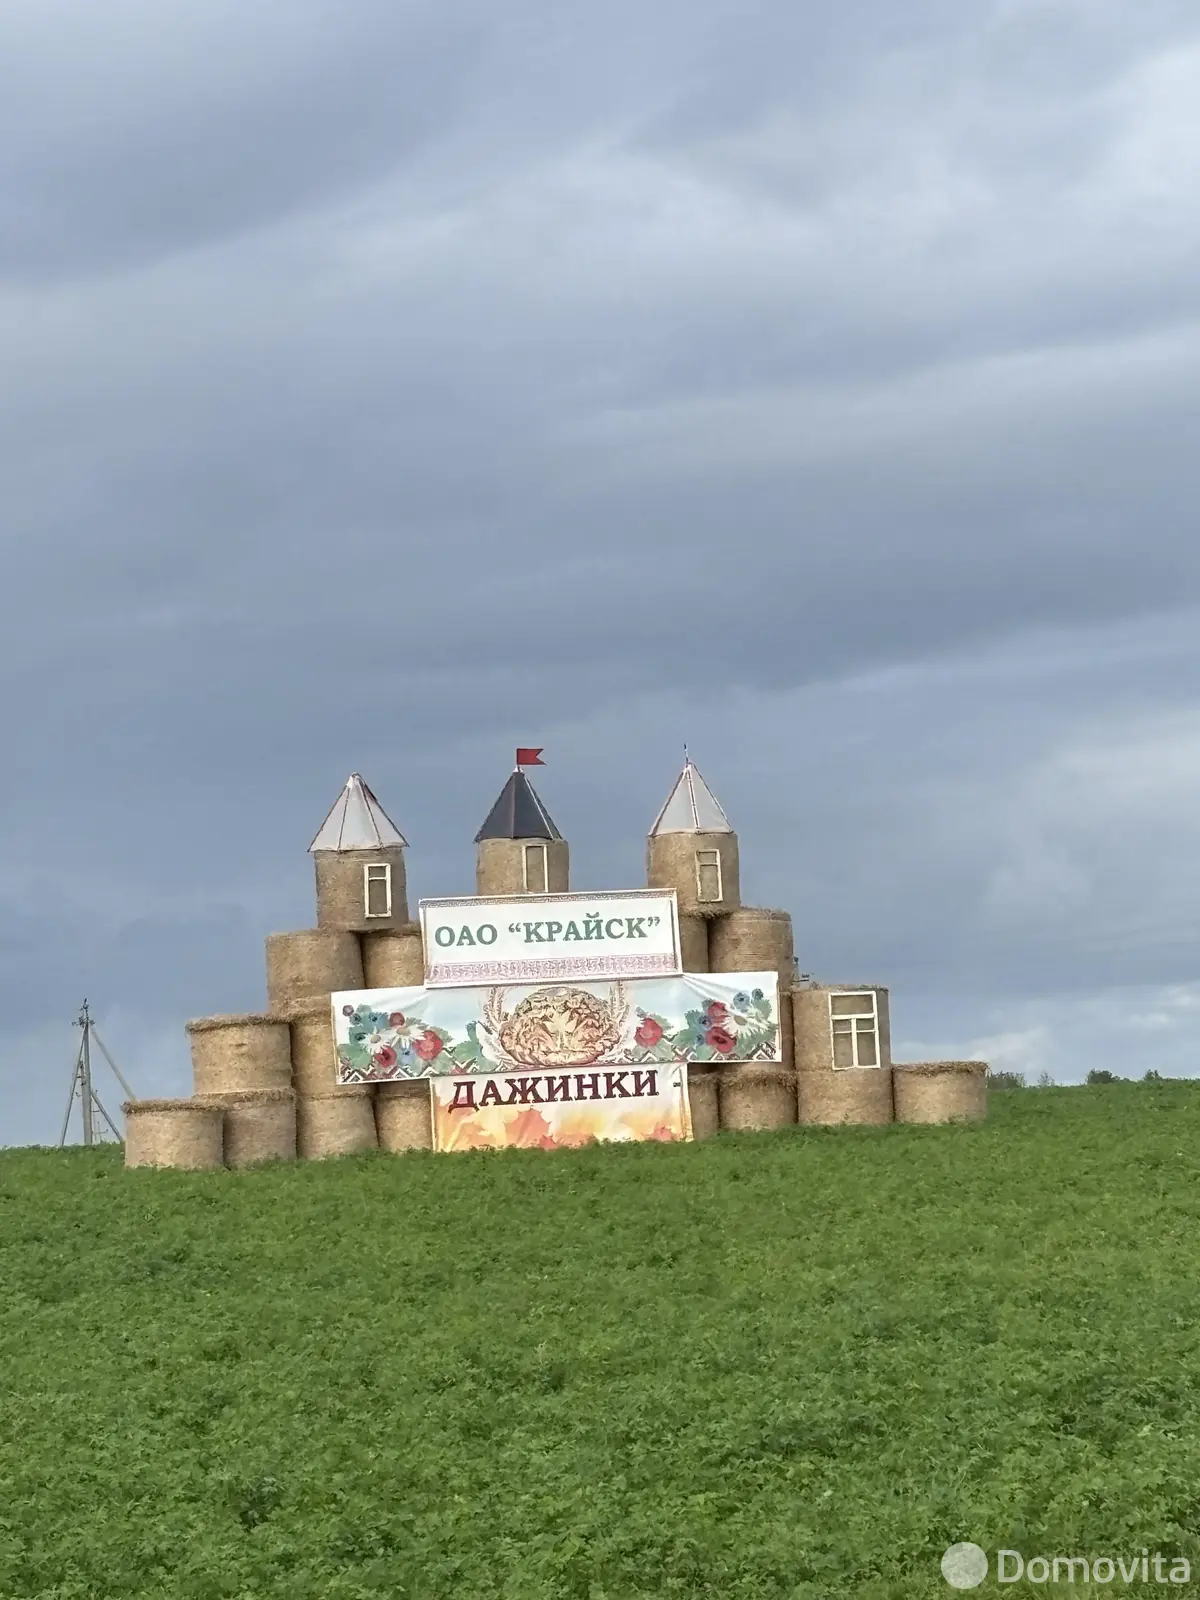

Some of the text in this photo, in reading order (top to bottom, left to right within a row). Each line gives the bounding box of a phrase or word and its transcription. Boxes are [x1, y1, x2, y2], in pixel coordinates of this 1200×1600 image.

[434, 911, 661, 947] ОАО “КРАЙСК”
[447, 1069, 660, 1114] ДАЖИНКИ
